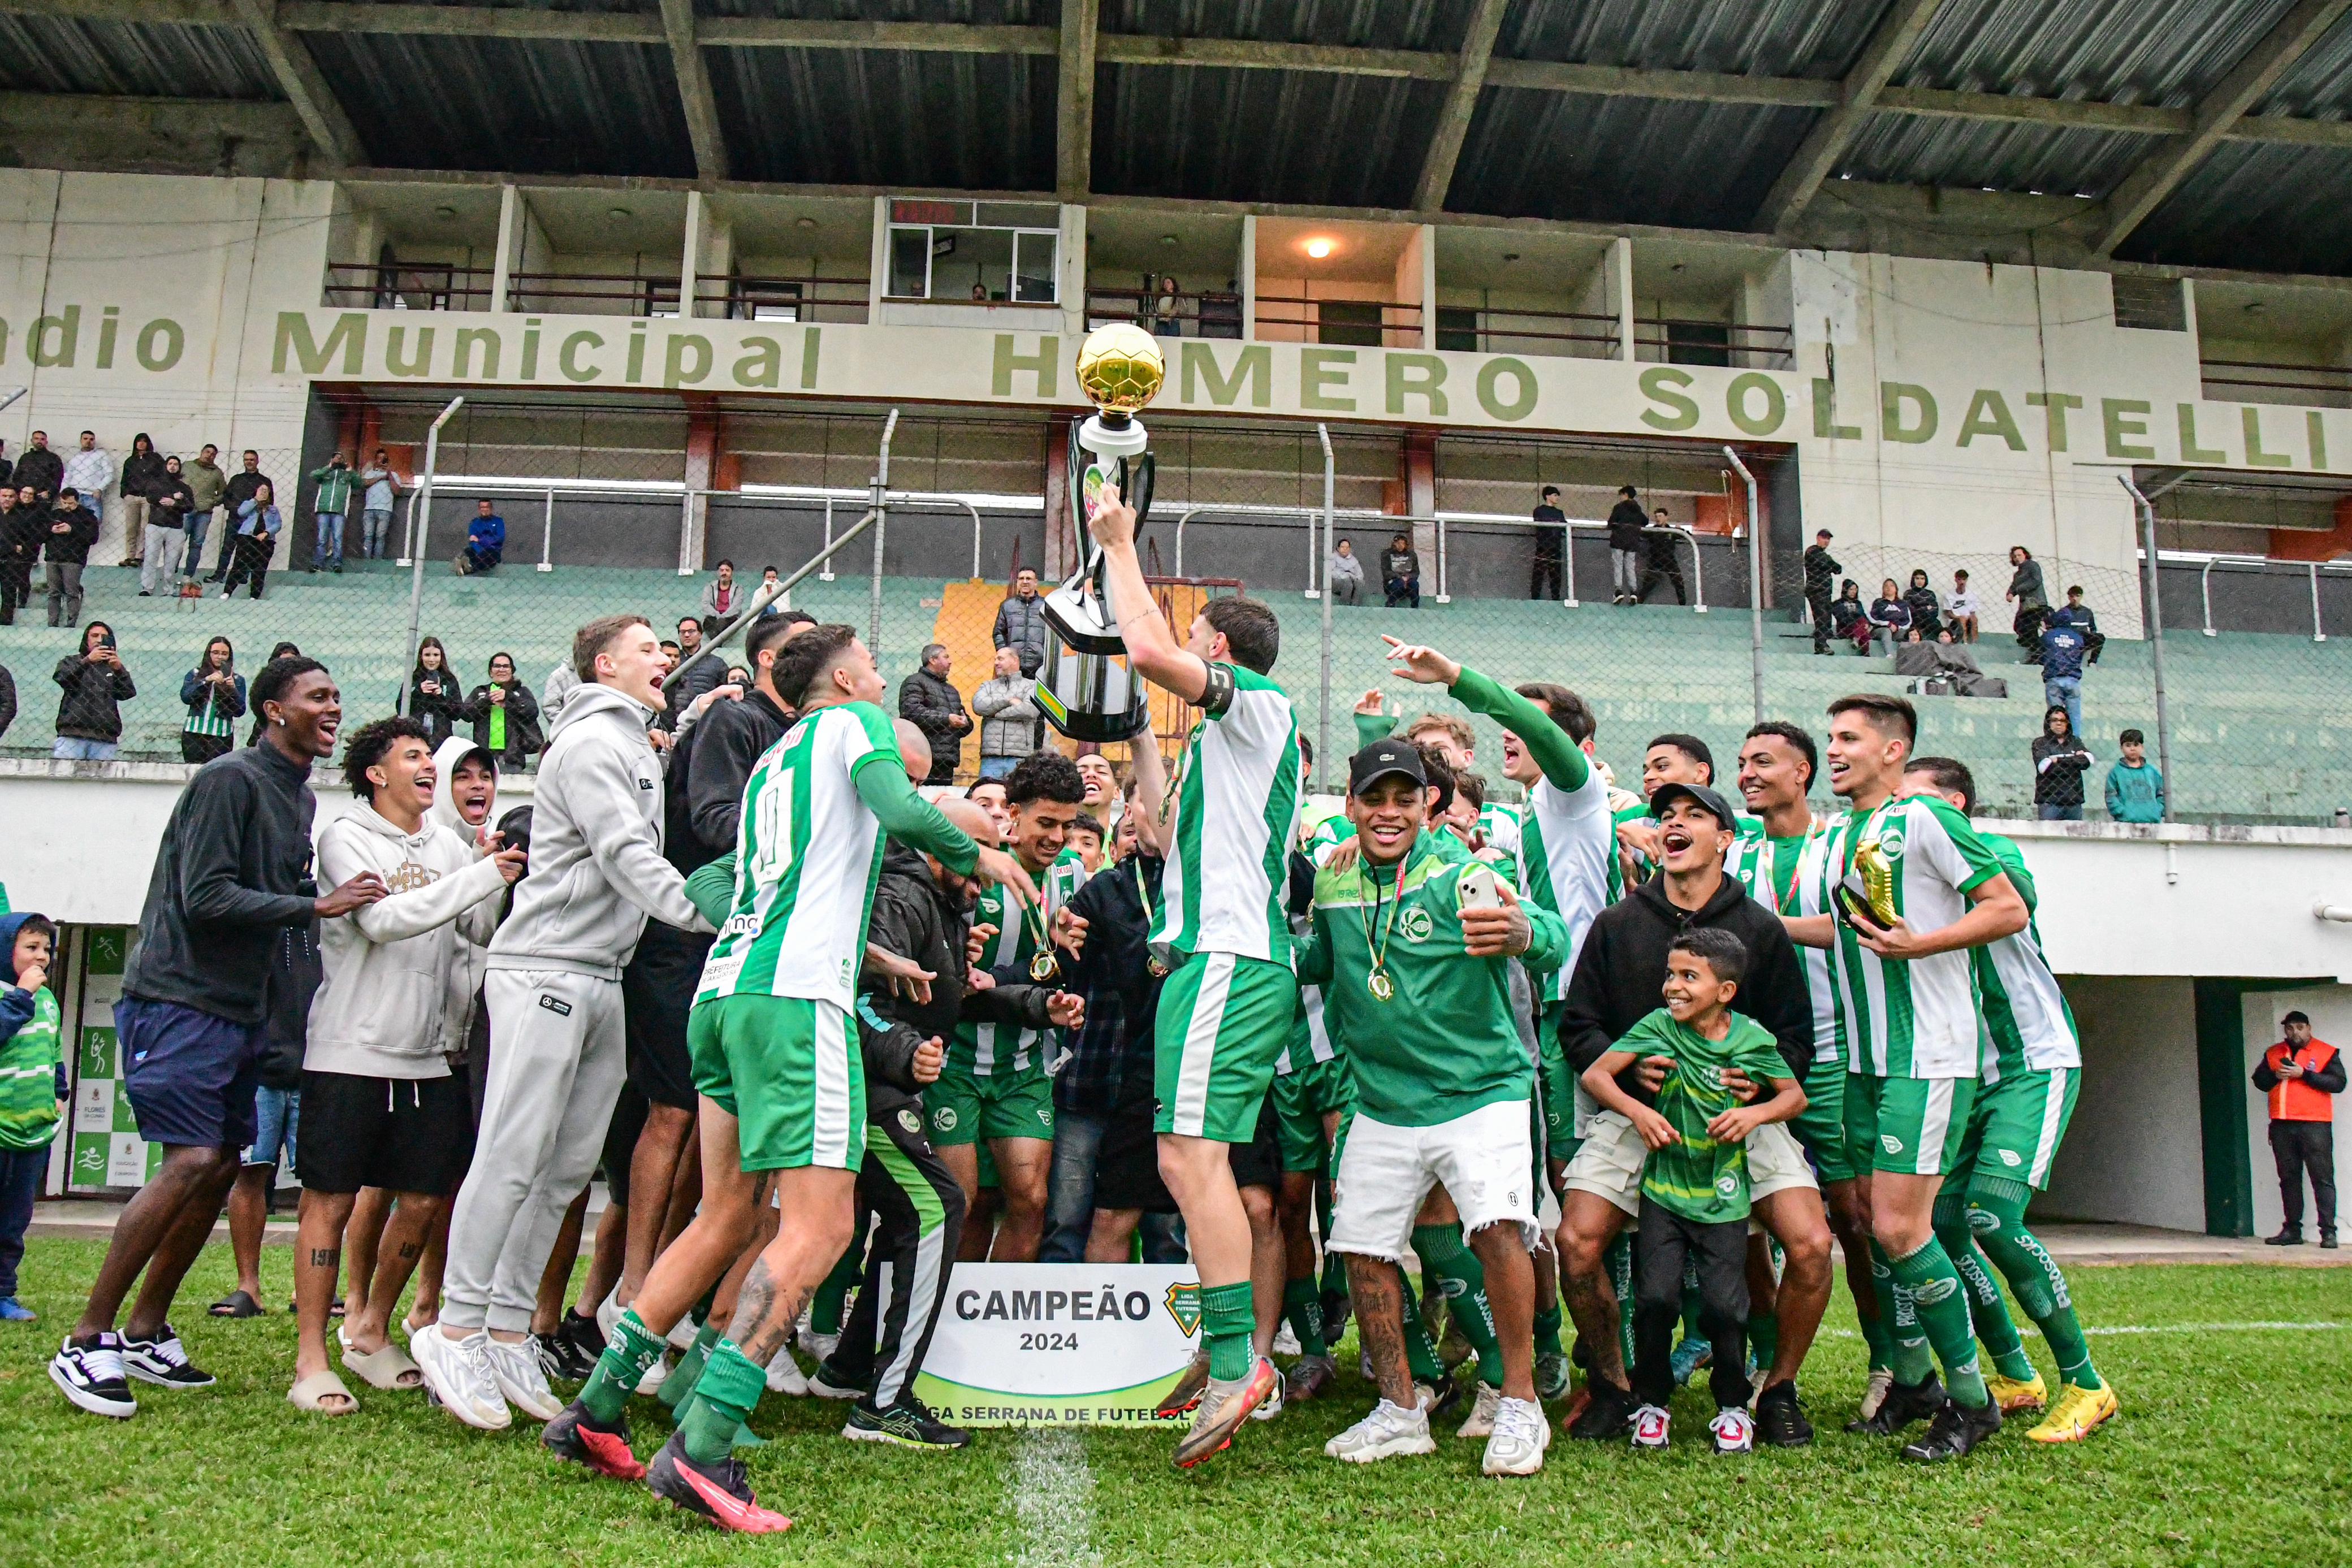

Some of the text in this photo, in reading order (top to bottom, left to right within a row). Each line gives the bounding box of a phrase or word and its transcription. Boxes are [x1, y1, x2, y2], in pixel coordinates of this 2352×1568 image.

[0, 305, 2327, 470] dio Municipal HMERO SOLDATELLI
[2014, 1235, 2072, 1310] PROSOCKS
[956, 1283, 1151, 1321] CAMPEÃO
[1019, 1333, 1079, 1350] 2024
[928, 1406, 954, 1419] GA
[962, 1406, 1057, 1420] SERRANA
[1065, 1407, 1090, 1421] DE
